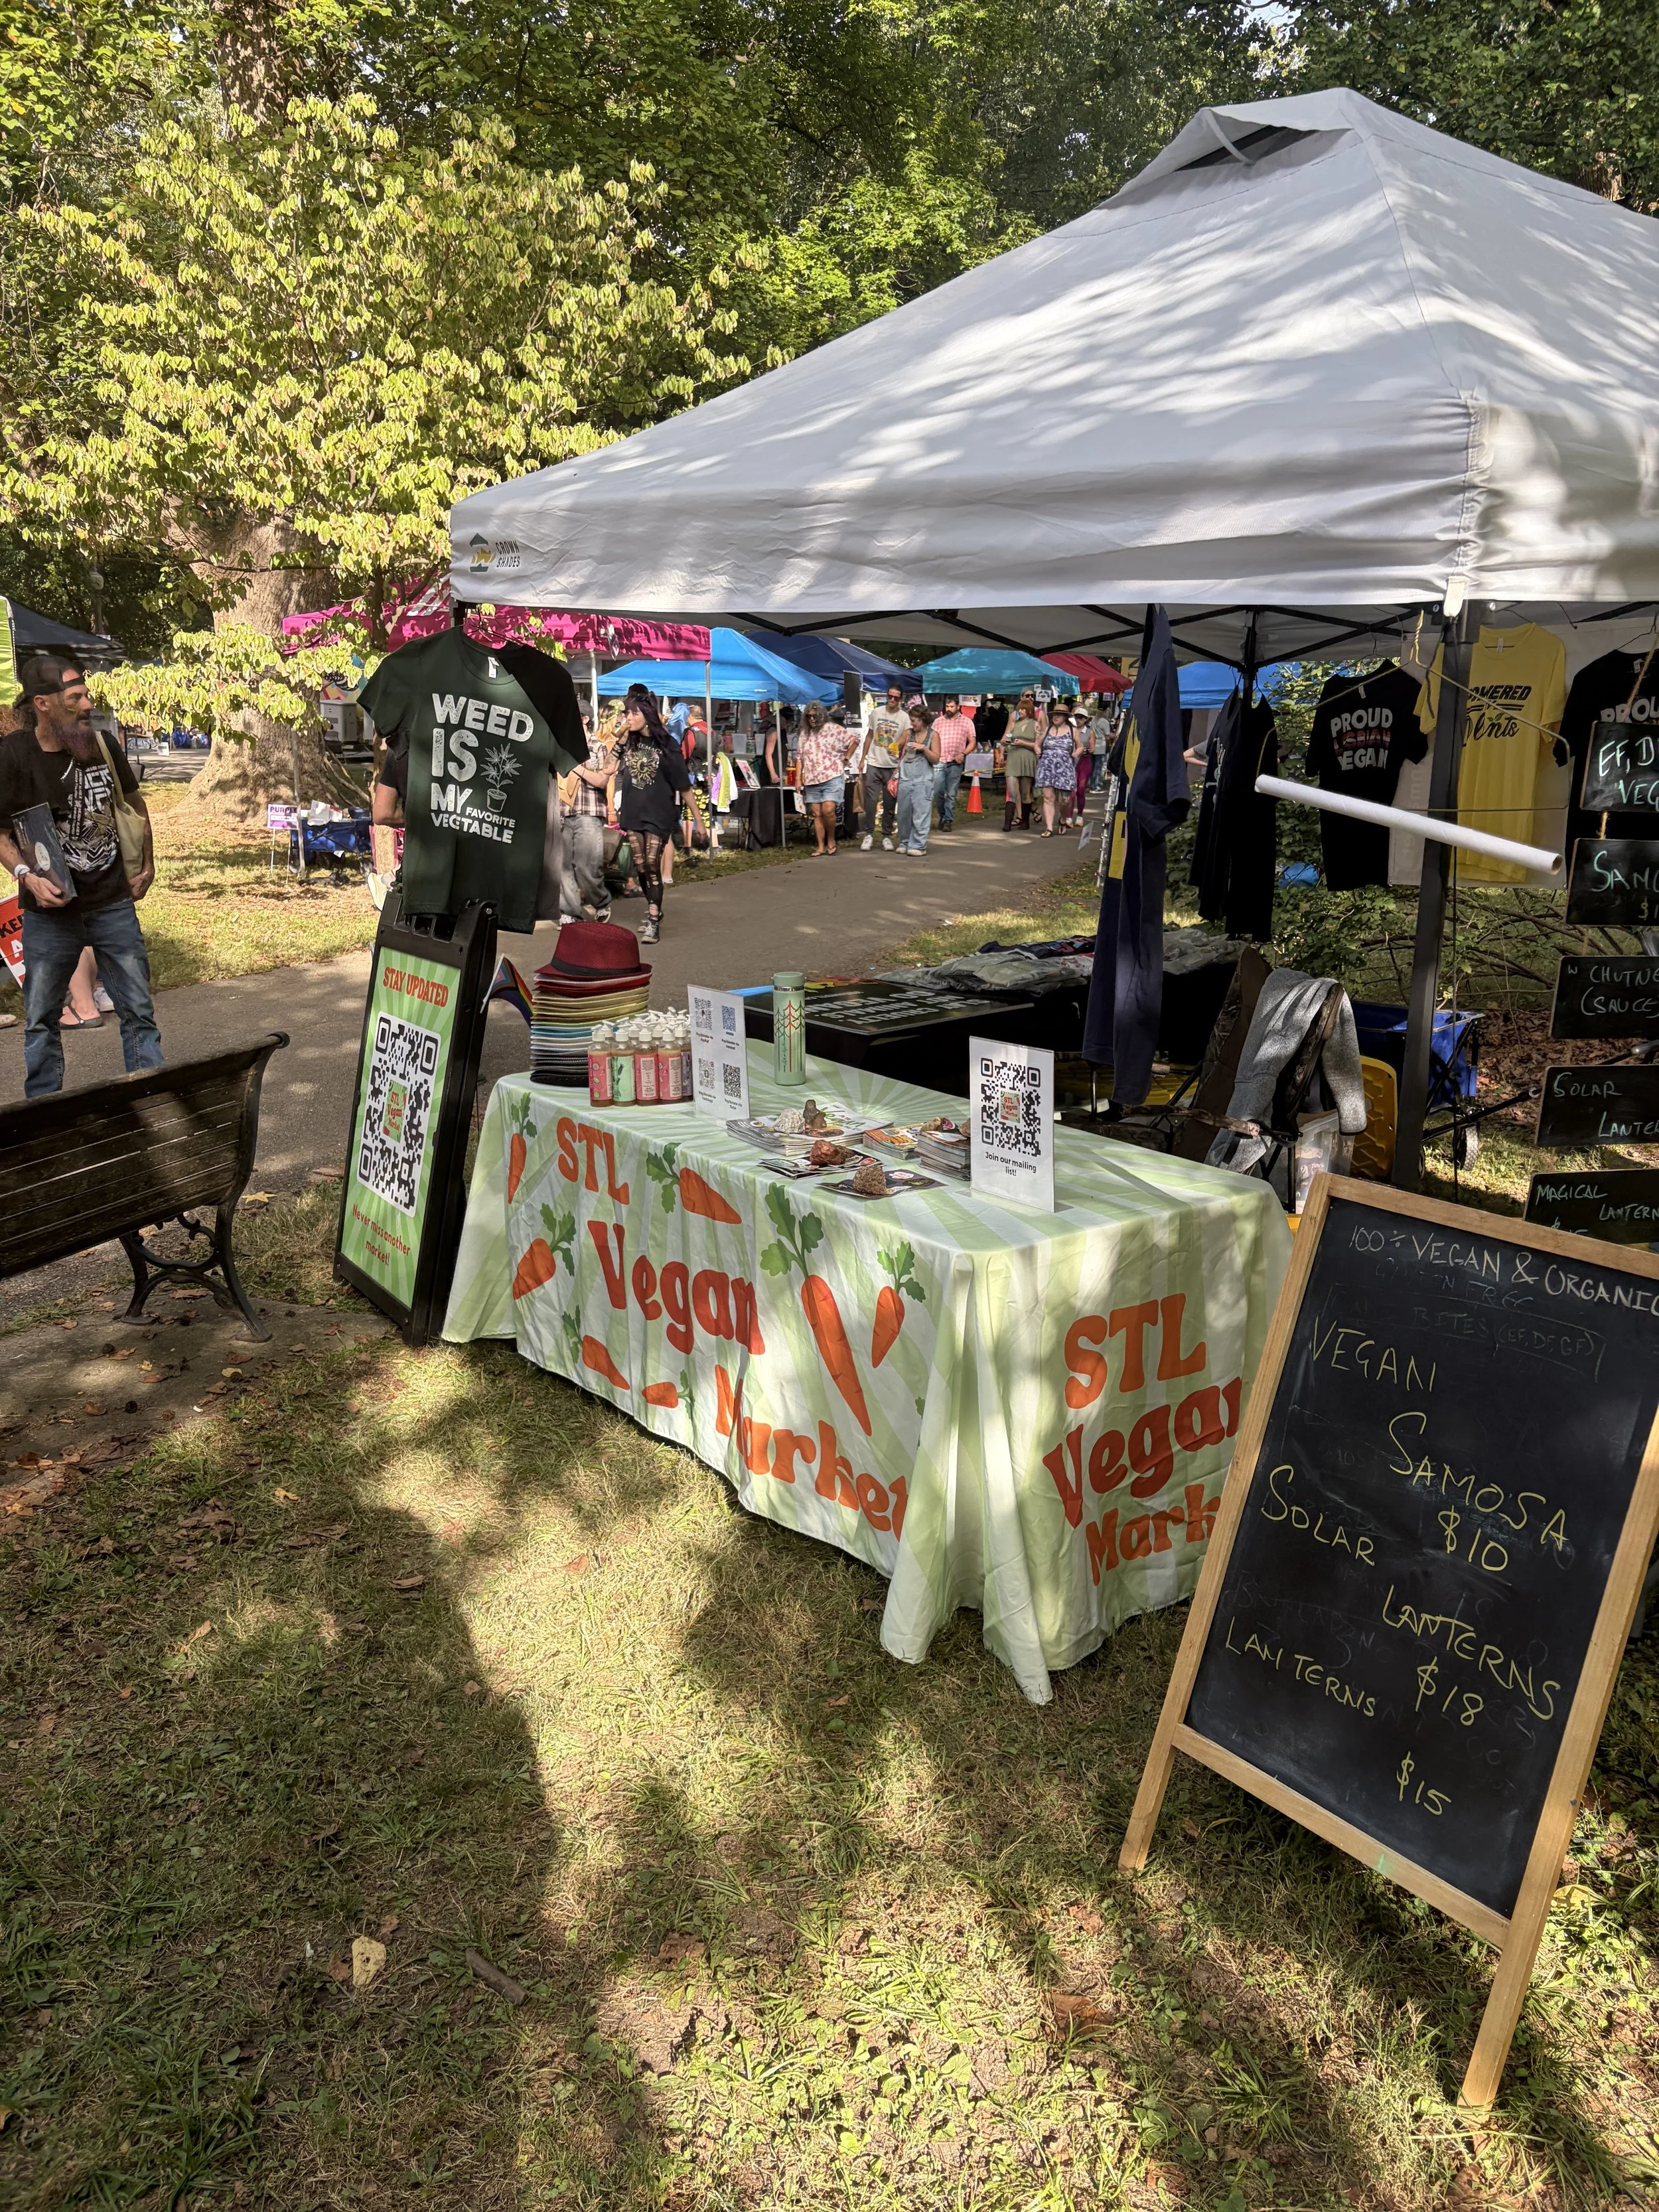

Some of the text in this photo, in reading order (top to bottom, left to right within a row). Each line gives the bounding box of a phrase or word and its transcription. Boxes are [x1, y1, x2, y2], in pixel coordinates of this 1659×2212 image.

[495, 540, 520, 555] CROWN
[496, 555, 521, 567] SHADES
[432, 694, 534, 742] WEED
[1330, 707, 1393, 738] PROUD
[432, 728, 479, 782] IS
[431, 782, 473, 814] MY
[466, 807, 516, 828] FAVORITE
[382, 966, 449, 1007] STAY UPDATED
[916, 995, 965, 1004] NOT
[936, 999, 990, 1009] SLAY
[390, 1090, 399, 1106] STL
[1553, 1072, 1623, 1098] SOLAR
[387, 1104, 403, 1122] Vegan
[556, 1116, 630, 1205] STL
[985, 1151, 999, 1161] Join
[1012, 1159, 1037, 1173] mailing
[1005, 1166, 1017, 1176] list!
[1535, 1185, 1608, 1205] MAGICAL
[352, 1204, 411, 1256] Never miss another
[365, 1241, 390, 1266] market!
[1412, 1232, 1500, 1283] VEGAN
[1511, 1252, 1540, 1284] &
[587, 1220, 766, 1355] Vegan
[1064, 1293, 1206, 1409] STL
[1309, 1315, 1437, 1393] VEGAN
[1388, 1412, 1568, 1552] SAMOSA
[1261, 1464, 1376, 1567] SOLAR
[1438, 1505, 1508, 1572] $10
[1382, 1585, 1561, 1722] LANTERNS
[1415, 1657, 1485, 1727] $18
[1396, 1751, 1452, 1816] $15
